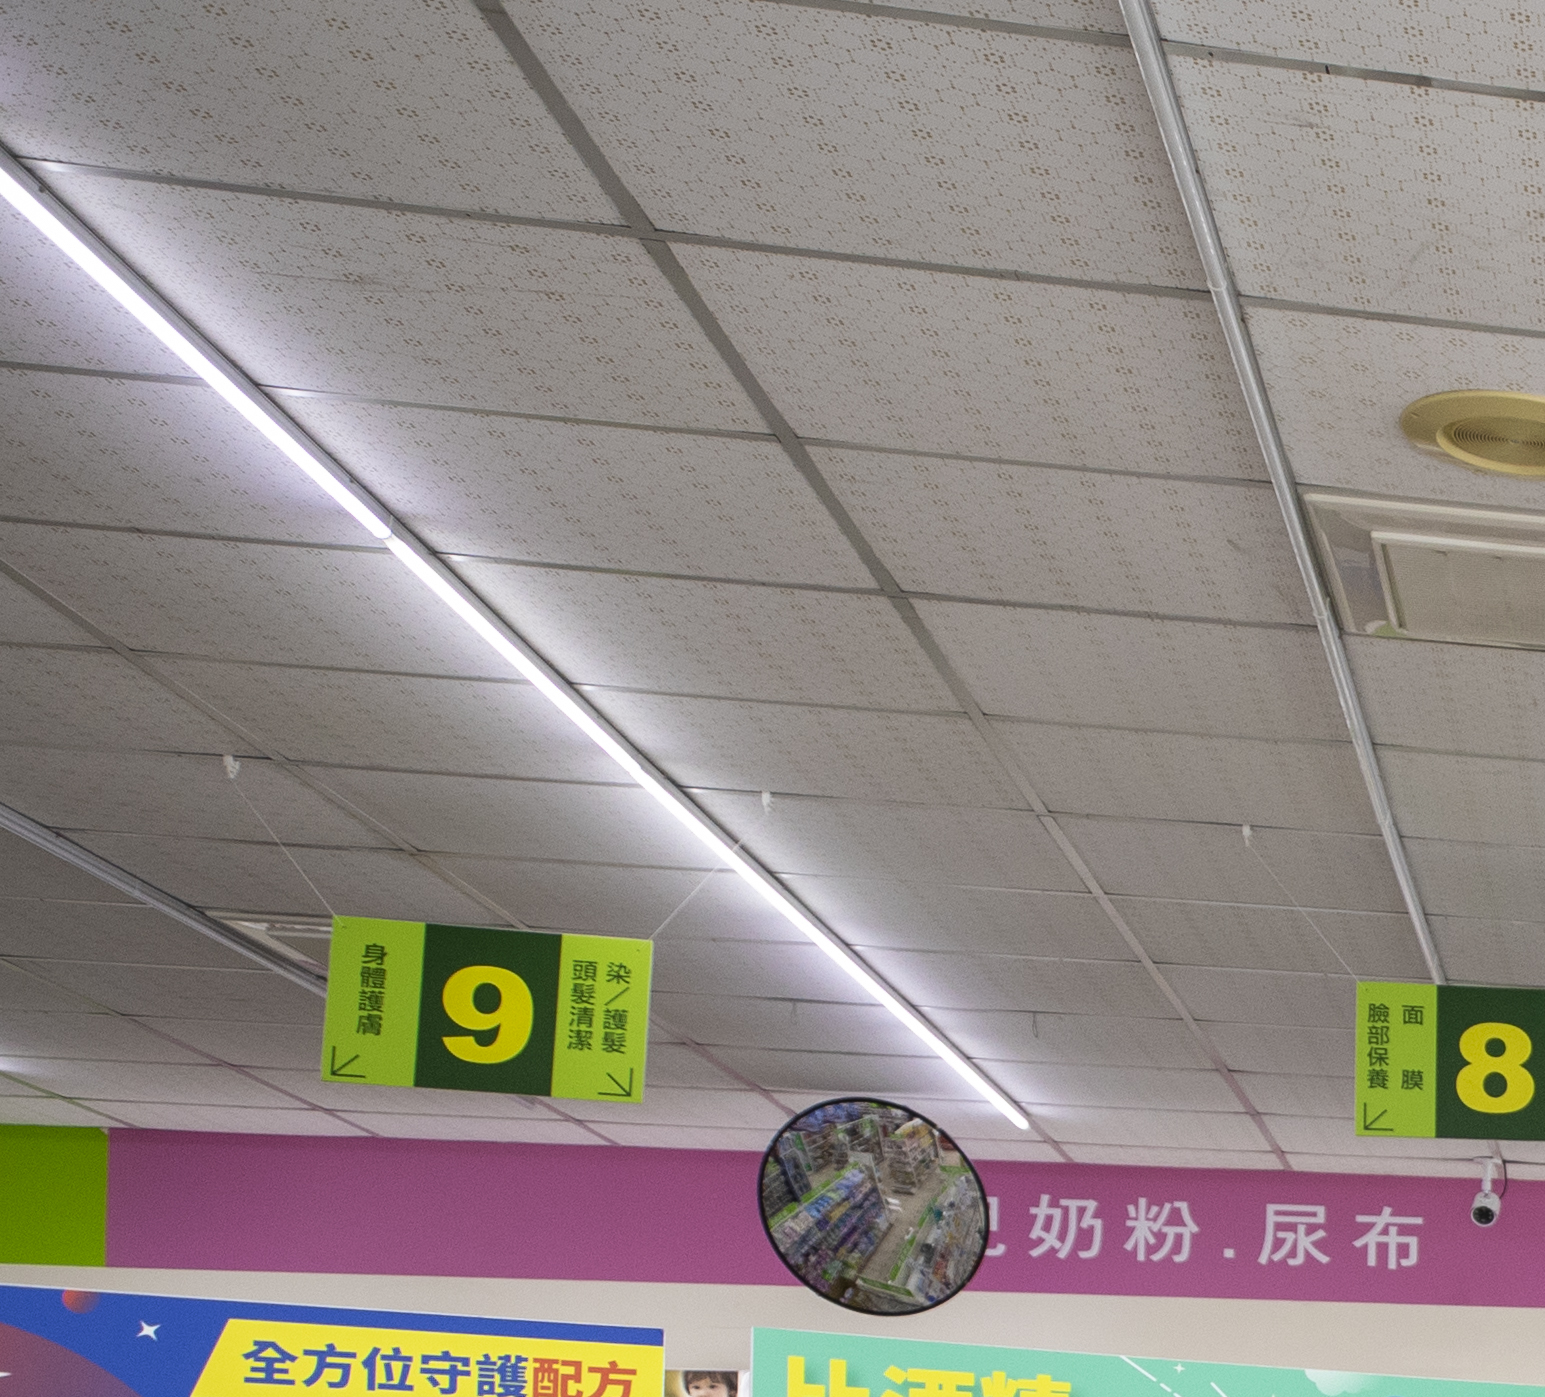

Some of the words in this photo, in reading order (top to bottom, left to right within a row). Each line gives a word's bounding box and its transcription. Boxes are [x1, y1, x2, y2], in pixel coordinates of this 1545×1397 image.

[355, 942, 388, 1036] 身體護膚
[441, 964, 535, 1064] 9
[567, 959, 598, 1052] 頭髮清潔
[1366, 1002, 1391, 1090] 臉部保養
[1455, 1021, 1536, 1114] 8
[981, 1194, 1424, 1268] 奶粉.尿布
